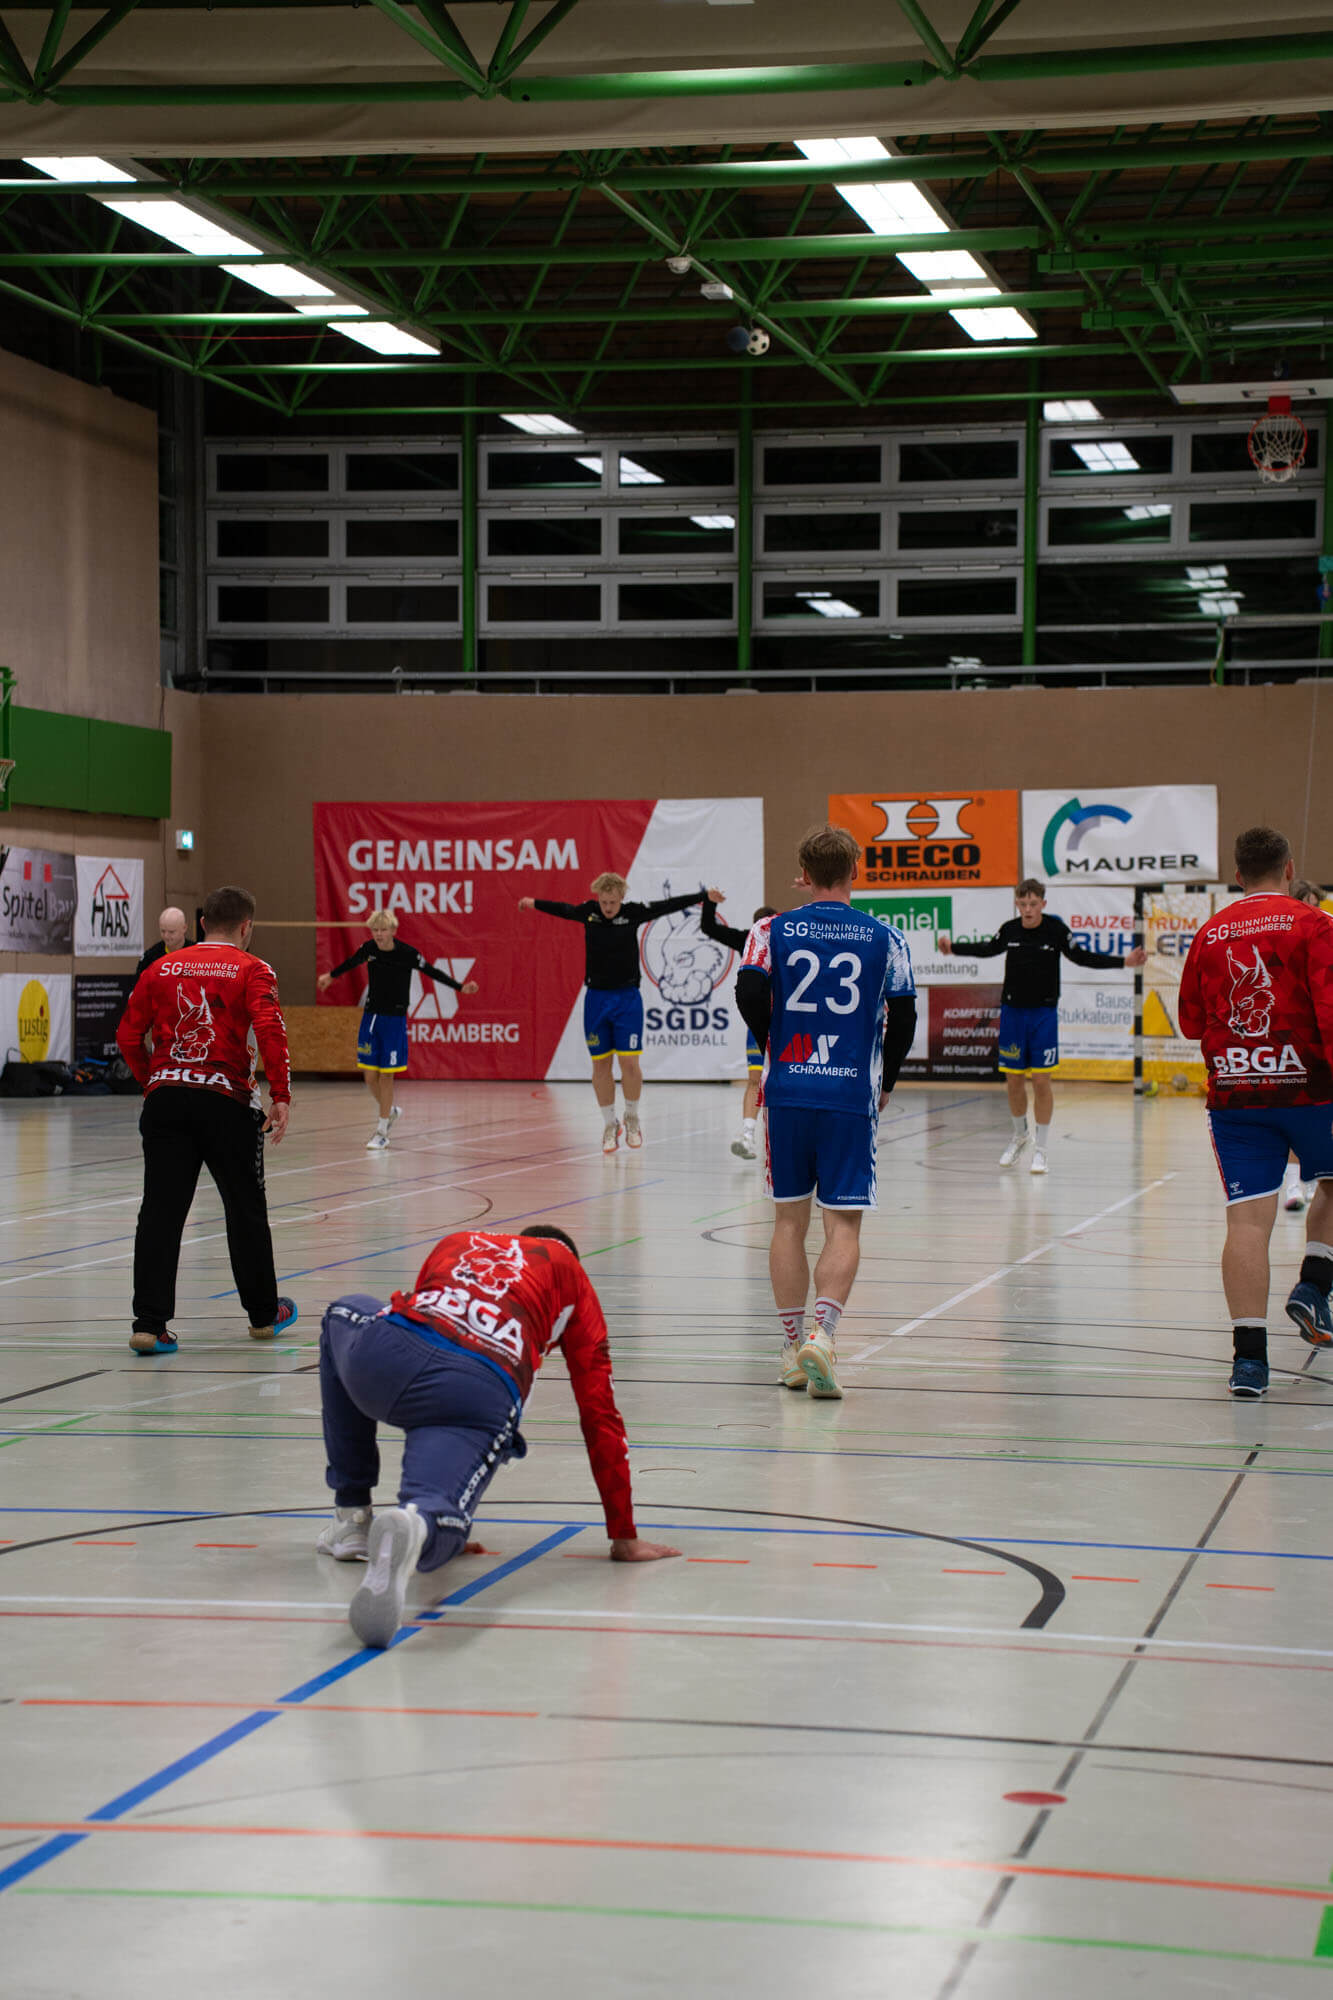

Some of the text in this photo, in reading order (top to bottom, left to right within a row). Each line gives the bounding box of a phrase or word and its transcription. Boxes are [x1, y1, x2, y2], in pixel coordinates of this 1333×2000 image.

[348, 838, 579, 871] GEMEINSAM
[866, 843, 980, 868] HECO
[1066, 854, 1199, 873] MAURER
[866, 868, 980, 882] SCHRAUBEN
[348, 880, 473, 914] STARK!
[91, 884, 130, 938] HAAS
[783, 922, 874, 937] SG DUNNINGEN
[1070, 915, 1199, 931] BAUZETRUM
[1206, 914, 1295, 945] SG DUNNINGEN
[1230, 922, 1292, 938] SCHRAMBERG
[809, 931, 873, 942] SCHRAMBERG
[160, 962, 240, 976] SG DUNNINGEN
[183, 969, 237, 979] SCHRAMBERG
[785, 950, 862, 1015] 23
[1096, 992, 1136, 1009] Bause
[646, 1008, 729, 1031] SGDS
[406, 1023, 519, 1043] HRAMBERG
[629, 1033, 638, 1049] 6
[646, 1033, 728, 1046] HANDBALL
[943, 1045, 992, 1056] KREATIV
[1043, 1047, 1057, 1066] 27
[1213, 1044, 1307, 1074] BBGA
[788, 1065, 858, 1078] SCHRAMBERG
